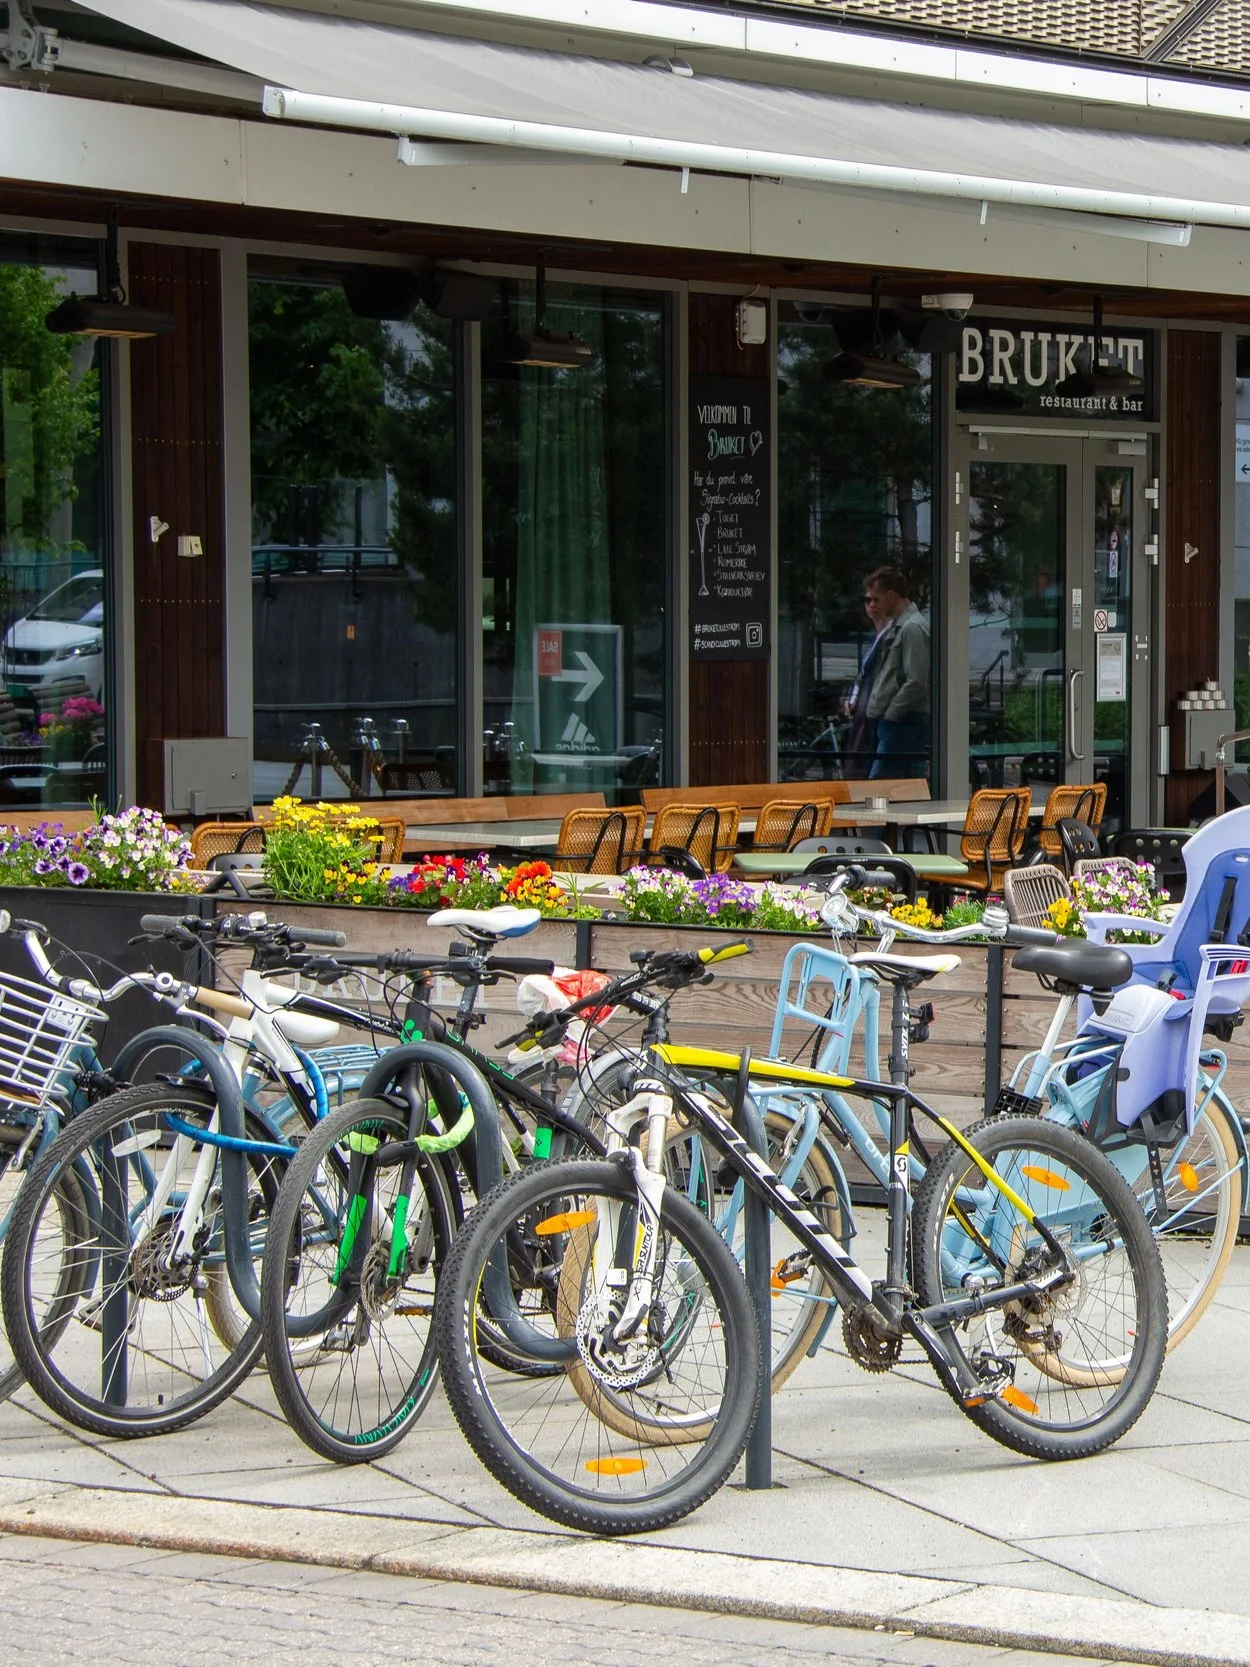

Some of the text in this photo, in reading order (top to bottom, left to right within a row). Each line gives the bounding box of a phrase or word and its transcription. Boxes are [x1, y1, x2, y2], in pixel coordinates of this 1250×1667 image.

[1040, 395, 1143, 411] restaurant & bar
[697, 405, 737, 424] VELKOMMEN
